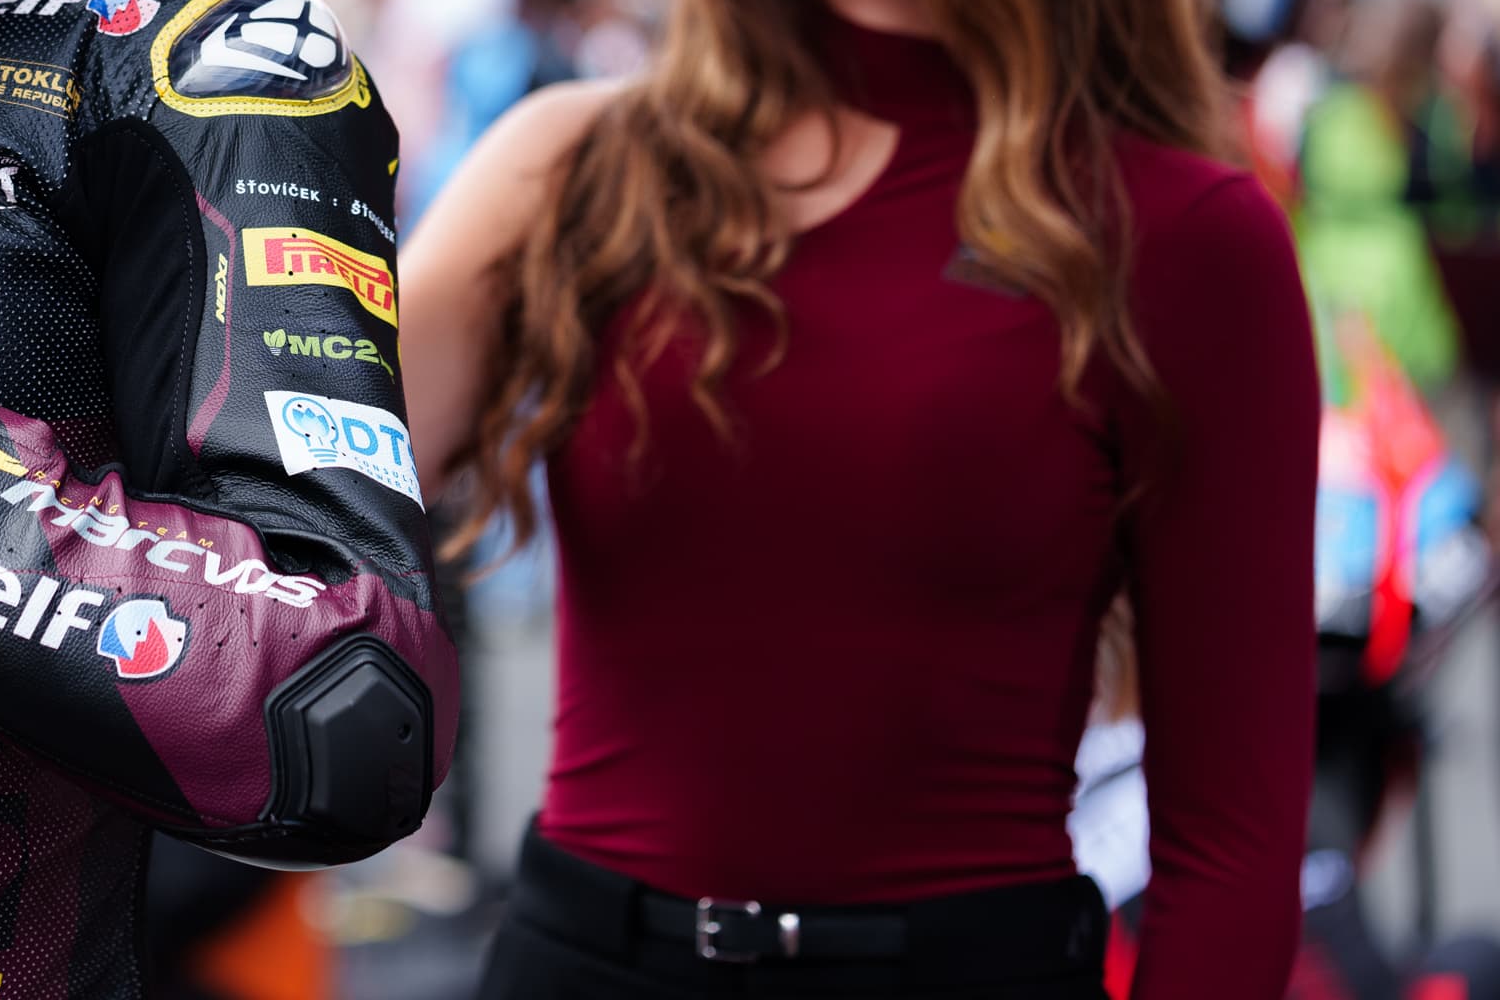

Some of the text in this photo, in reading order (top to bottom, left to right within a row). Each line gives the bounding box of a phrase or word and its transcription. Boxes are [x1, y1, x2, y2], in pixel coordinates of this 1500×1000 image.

[235, 179, 320, 202] ŠŤOVÍČEK
[264, 238, 393, 311] PIRELLI
[137, 520, 214, 549] TEAM
